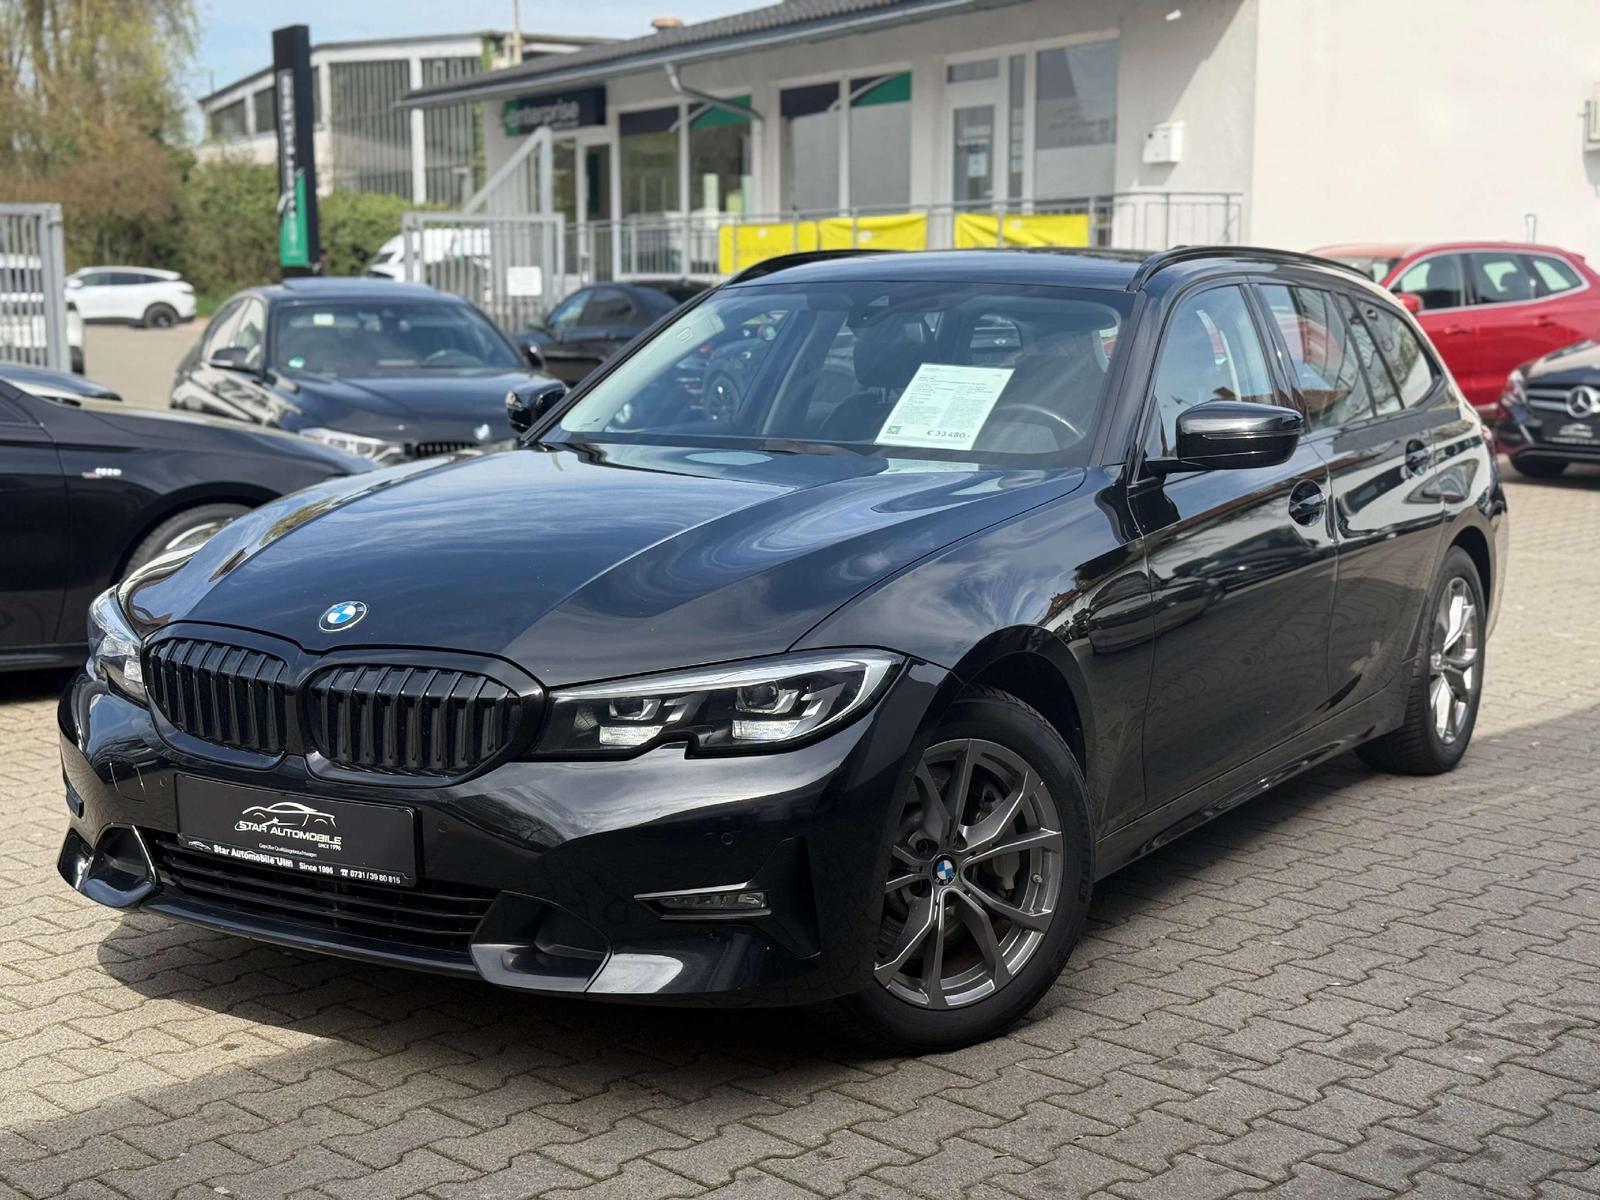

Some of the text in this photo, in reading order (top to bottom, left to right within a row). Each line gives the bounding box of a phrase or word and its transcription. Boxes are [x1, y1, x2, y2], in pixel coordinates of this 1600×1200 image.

[239, 820, 342, 845] STAR AUTOMOBILE
[213, 844, 229, 856] Star
[231, 847, 275, 865] Automobile
[275, 857, 293, 868] Ulm
[299, 862, 318, 872] Since
